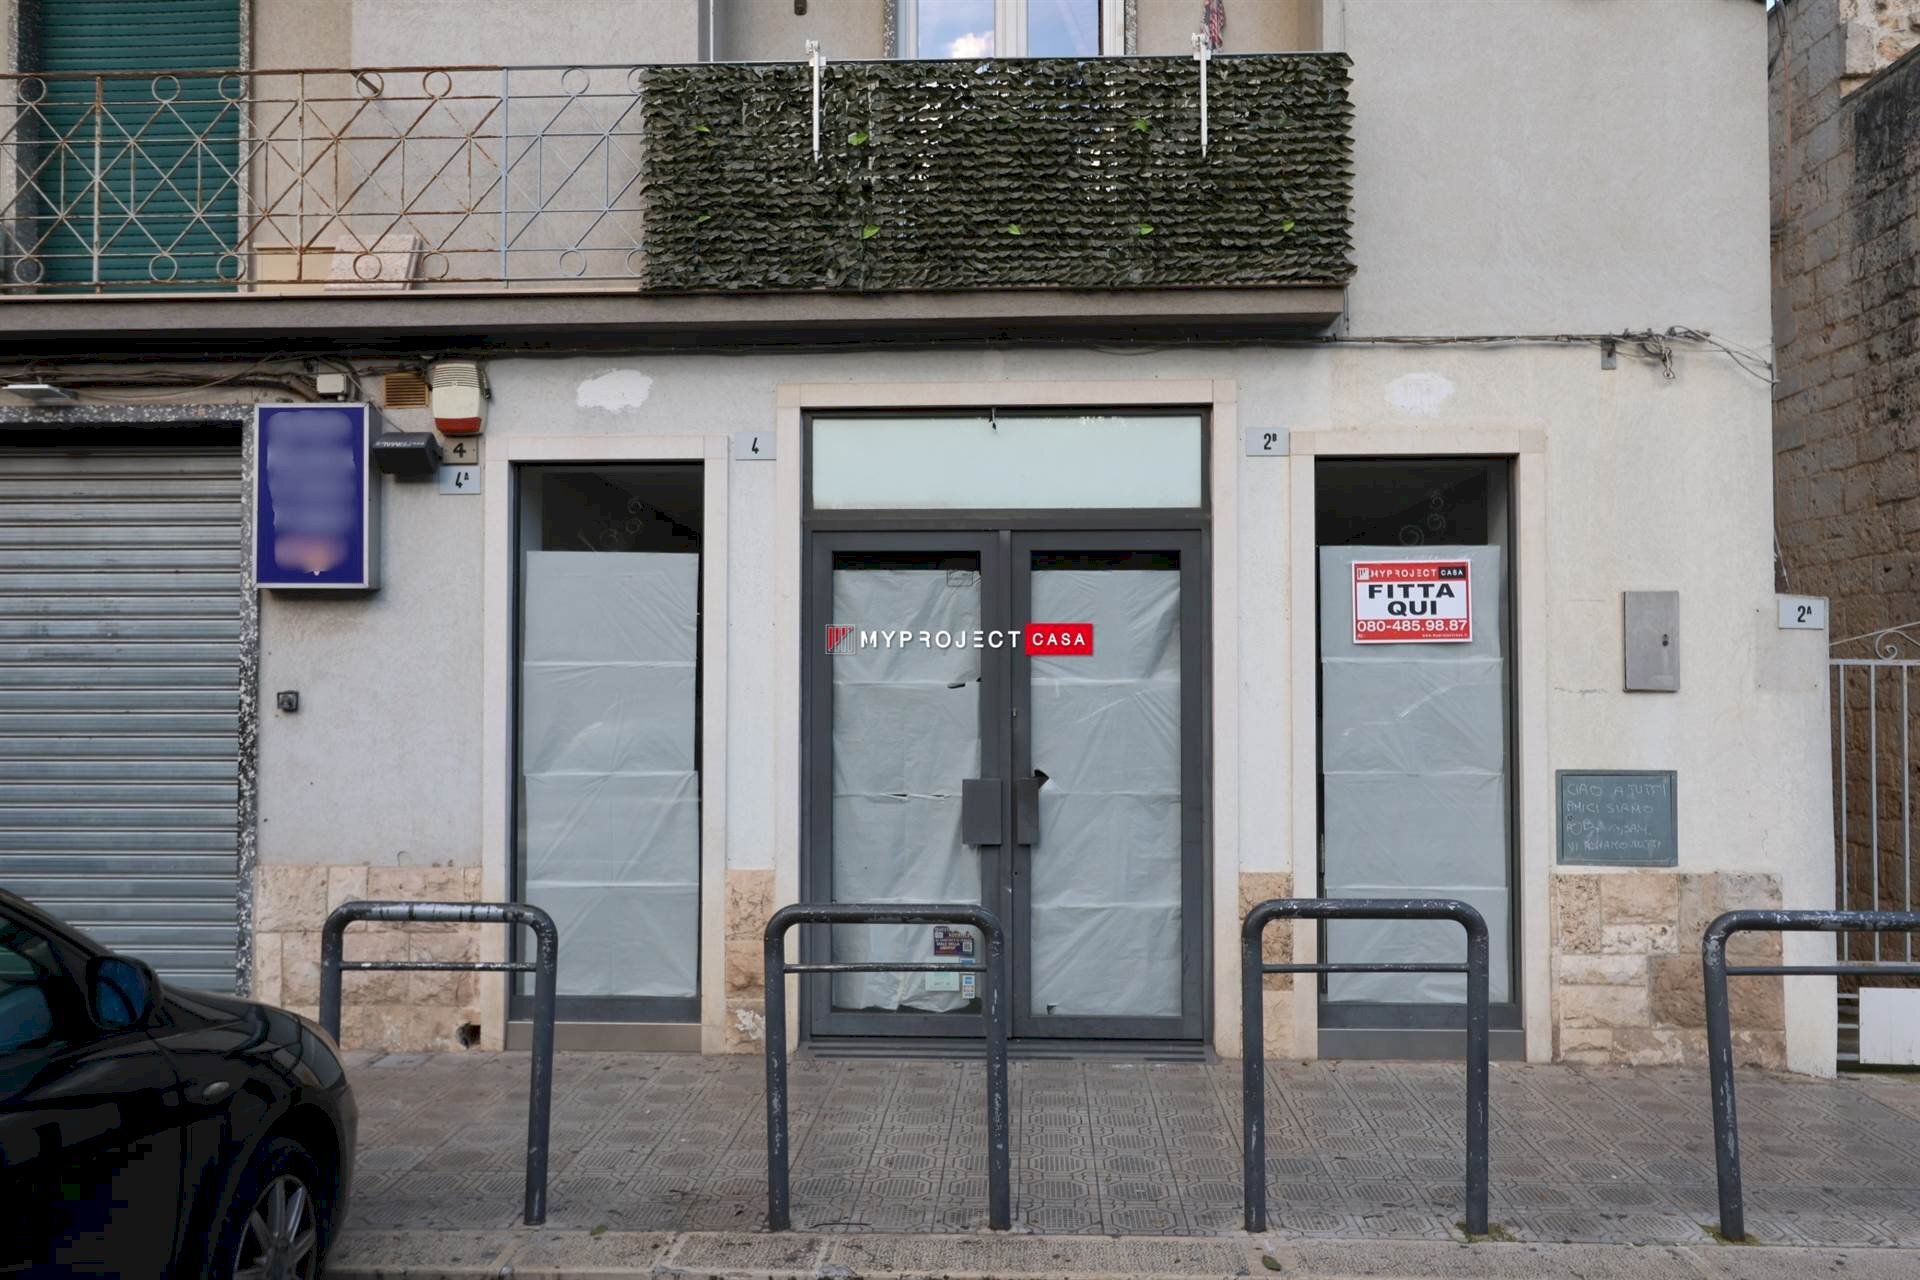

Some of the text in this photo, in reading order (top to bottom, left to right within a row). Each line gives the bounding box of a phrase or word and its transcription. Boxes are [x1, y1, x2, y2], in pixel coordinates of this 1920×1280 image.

[452, 442, 467, 458] 4
[751, 436, 760, 454] 4
[455, 471, 470, 488] 4A
[1371, 568, 1464, 579] MYPROJECT CASA
[1368, 583, 1455, 599] FITTA
[1387, 600, 1438, 617] QUI
[1797, 605, 1812, 623] 2A
[1357, 619, 1468, 632] 080-485.98.87
[1567, 783, 1602, 797] CIAO
